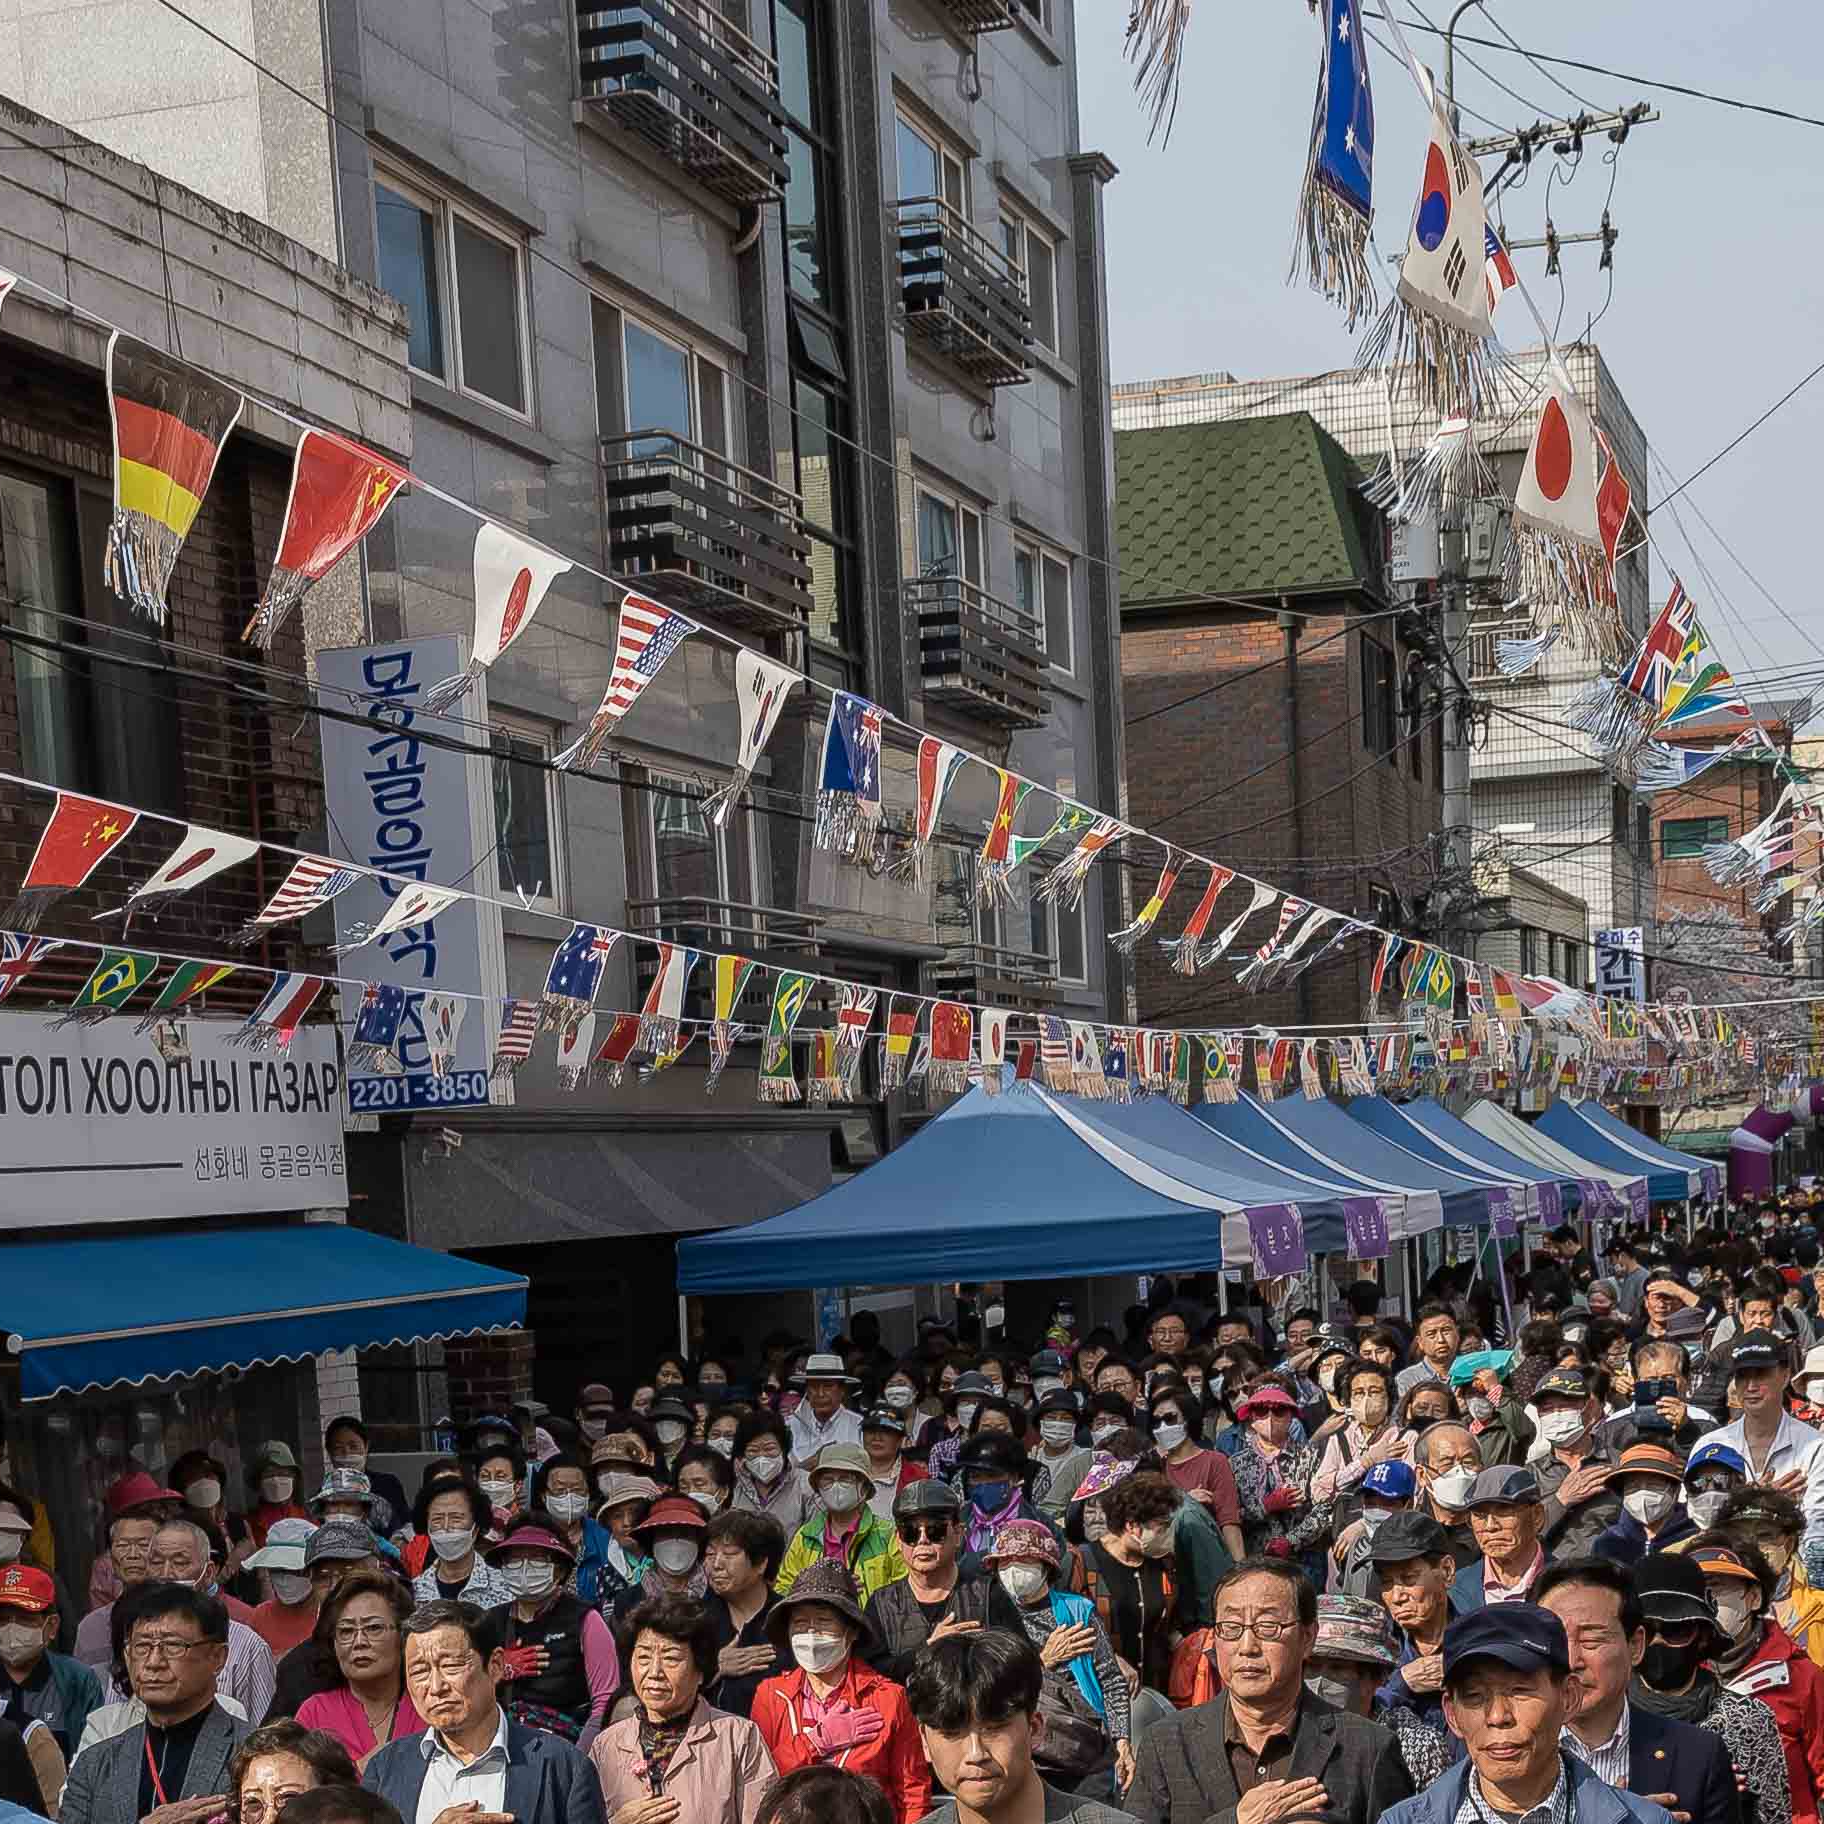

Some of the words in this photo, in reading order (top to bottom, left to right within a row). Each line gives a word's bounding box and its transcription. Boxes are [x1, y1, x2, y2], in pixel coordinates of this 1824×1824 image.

[84, 1054, 241, 1115] ХООЛНЫ
[249, 1060, 339, 1114] ГАЗАР
[352, 1072, 488, 1111] 2201-3850
[194, 1142, 249, 1183] 선화네
[259, 1142, 345, 1182] 몽골음식점
